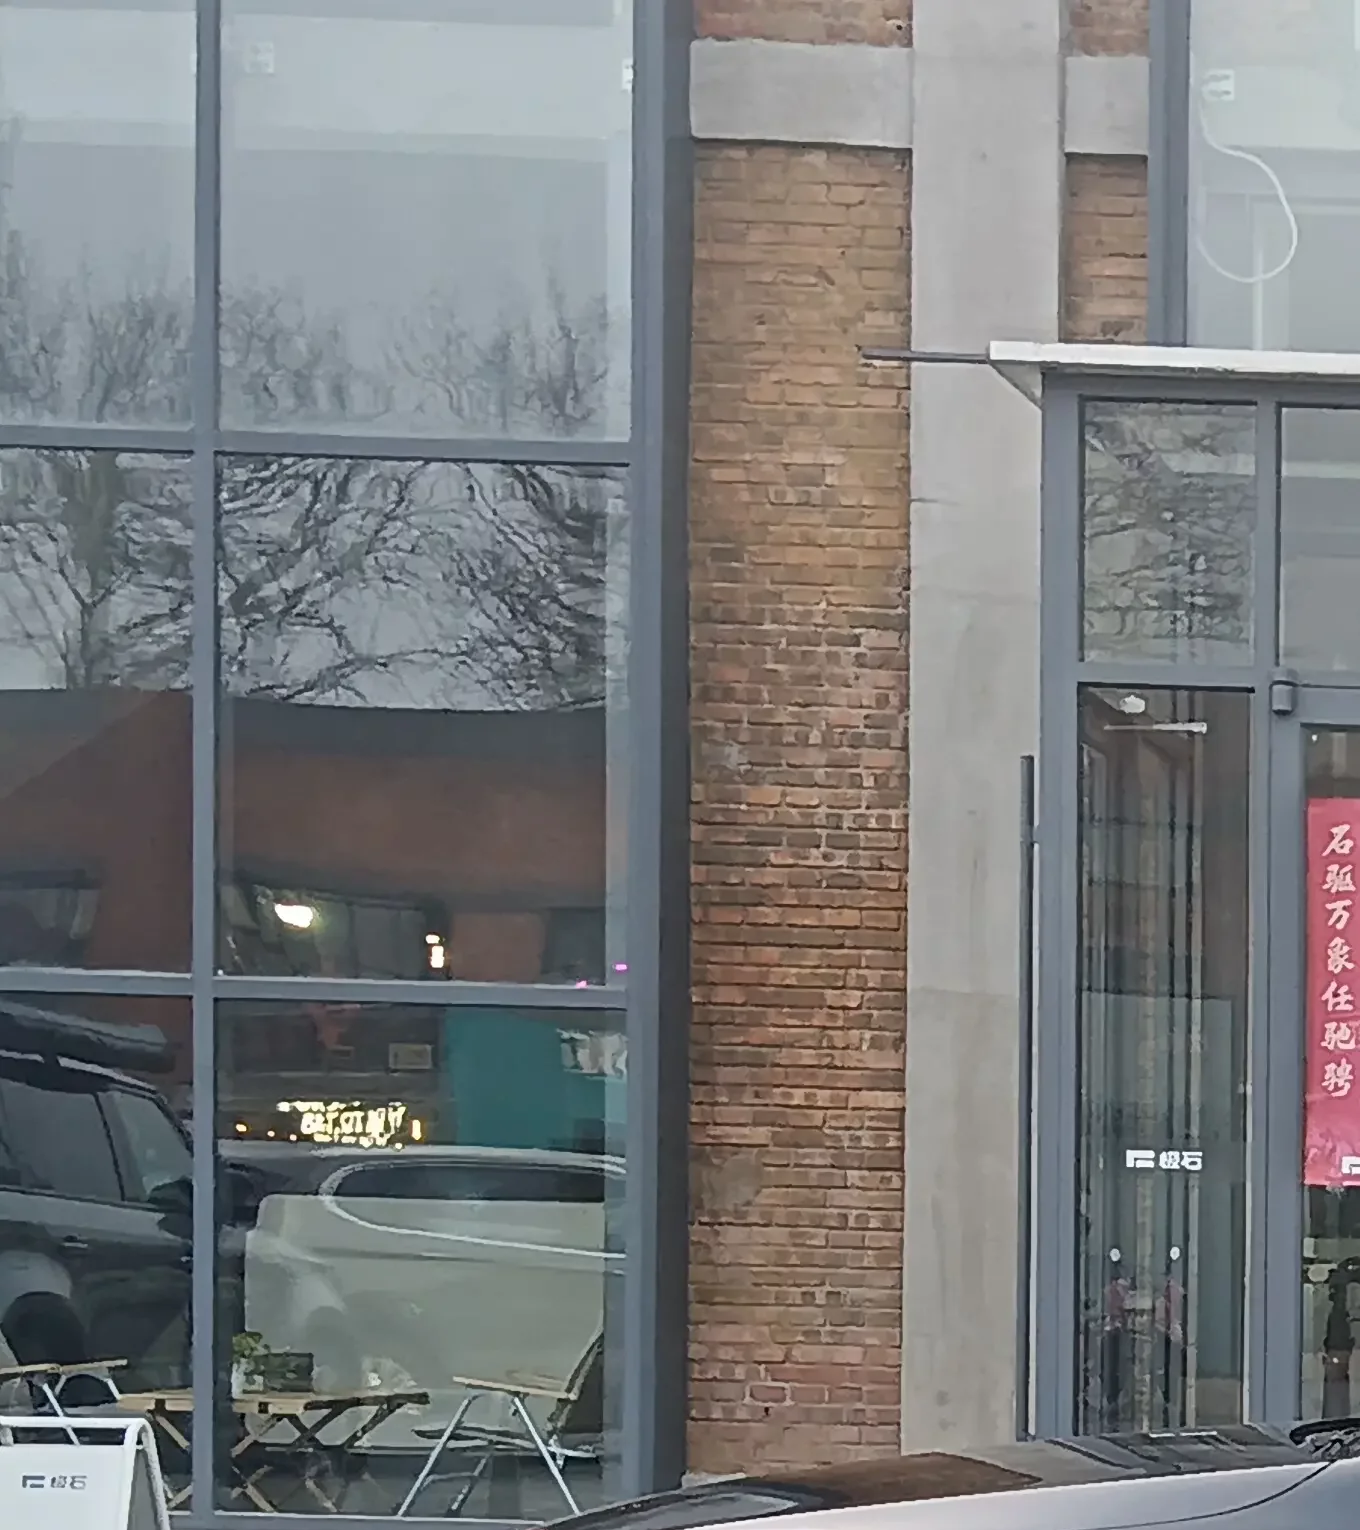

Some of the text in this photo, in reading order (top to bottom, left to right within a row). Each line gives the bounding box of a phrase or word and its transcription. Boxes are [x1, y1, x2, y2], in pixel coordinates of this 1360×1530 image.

[1320, 823, 1357, 1098] 石驱万象任驰骋
